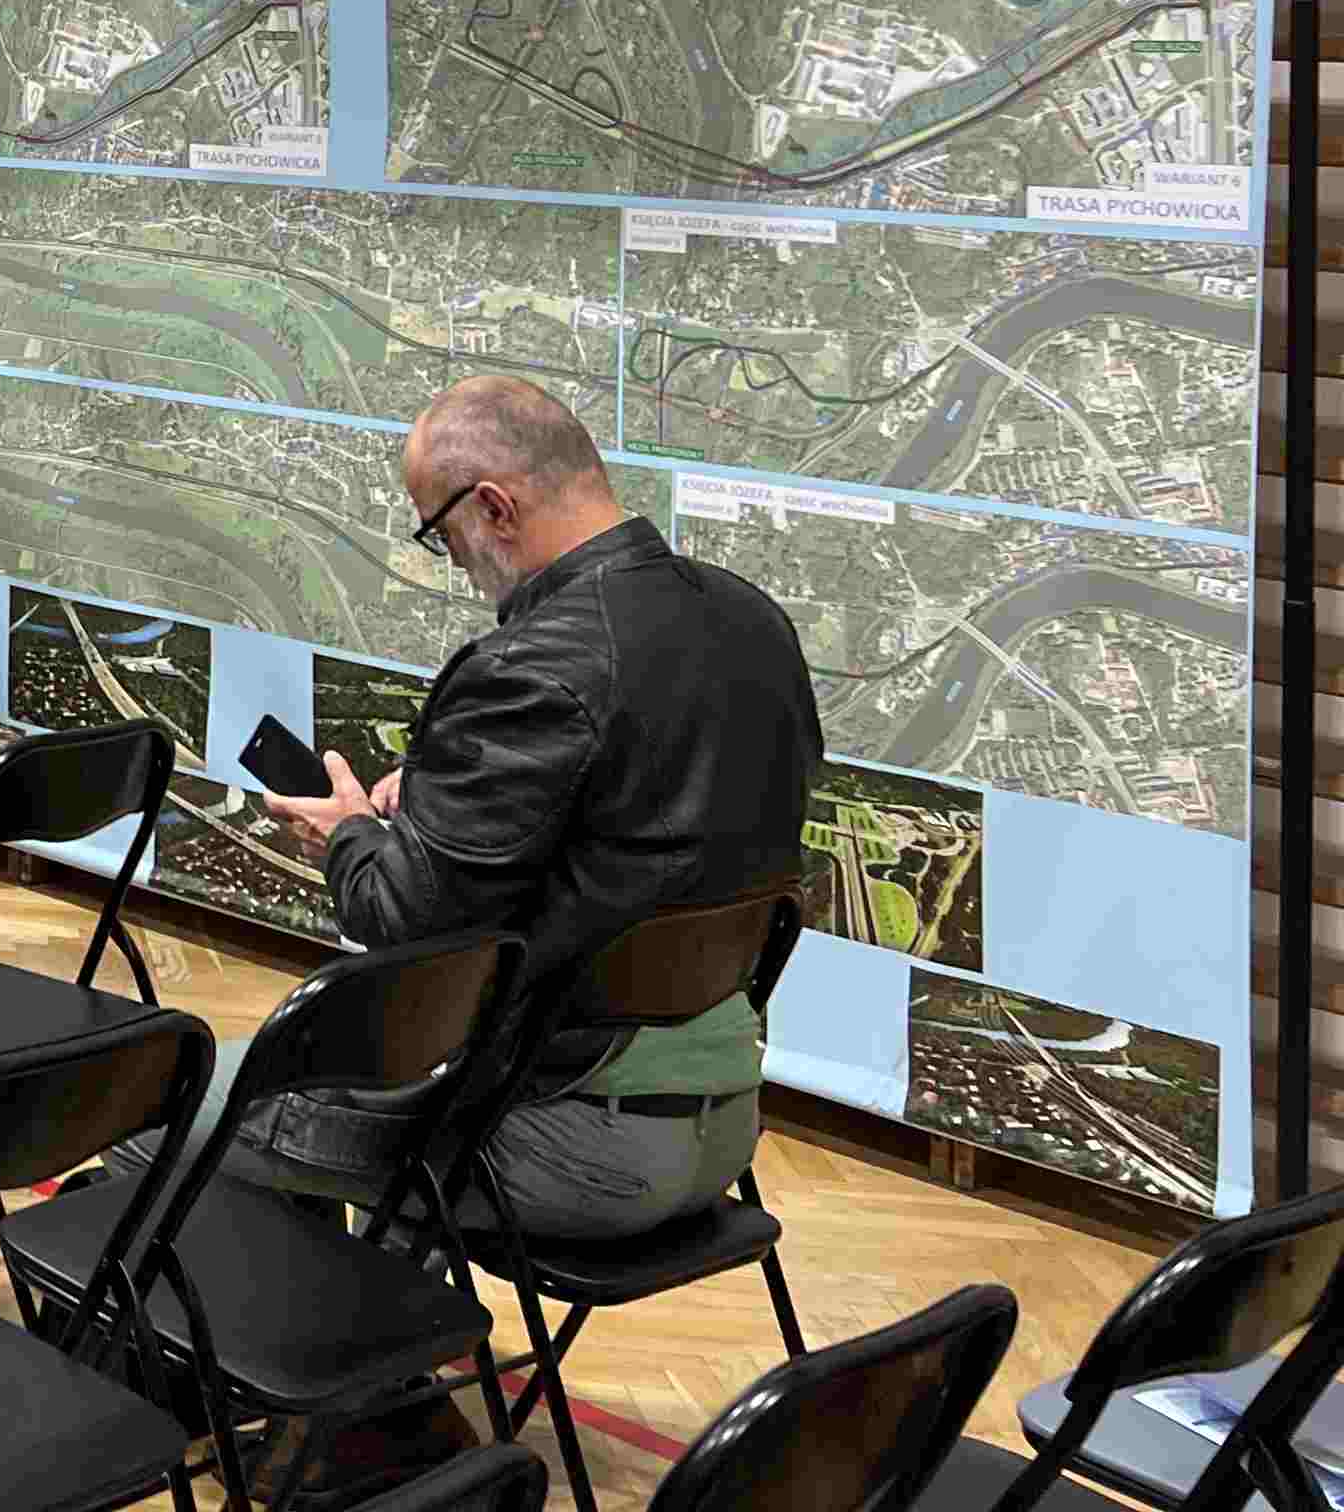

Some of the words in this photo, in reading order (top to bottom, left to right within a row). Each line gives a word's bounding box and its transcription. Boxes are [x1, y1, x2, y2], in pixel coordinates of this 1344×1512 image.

[197, 151, 233, 166] TRASA
[1037, 195, 1101, 214] TRASA
[1107, 199, 1242, 222] PYCHOWICKA
